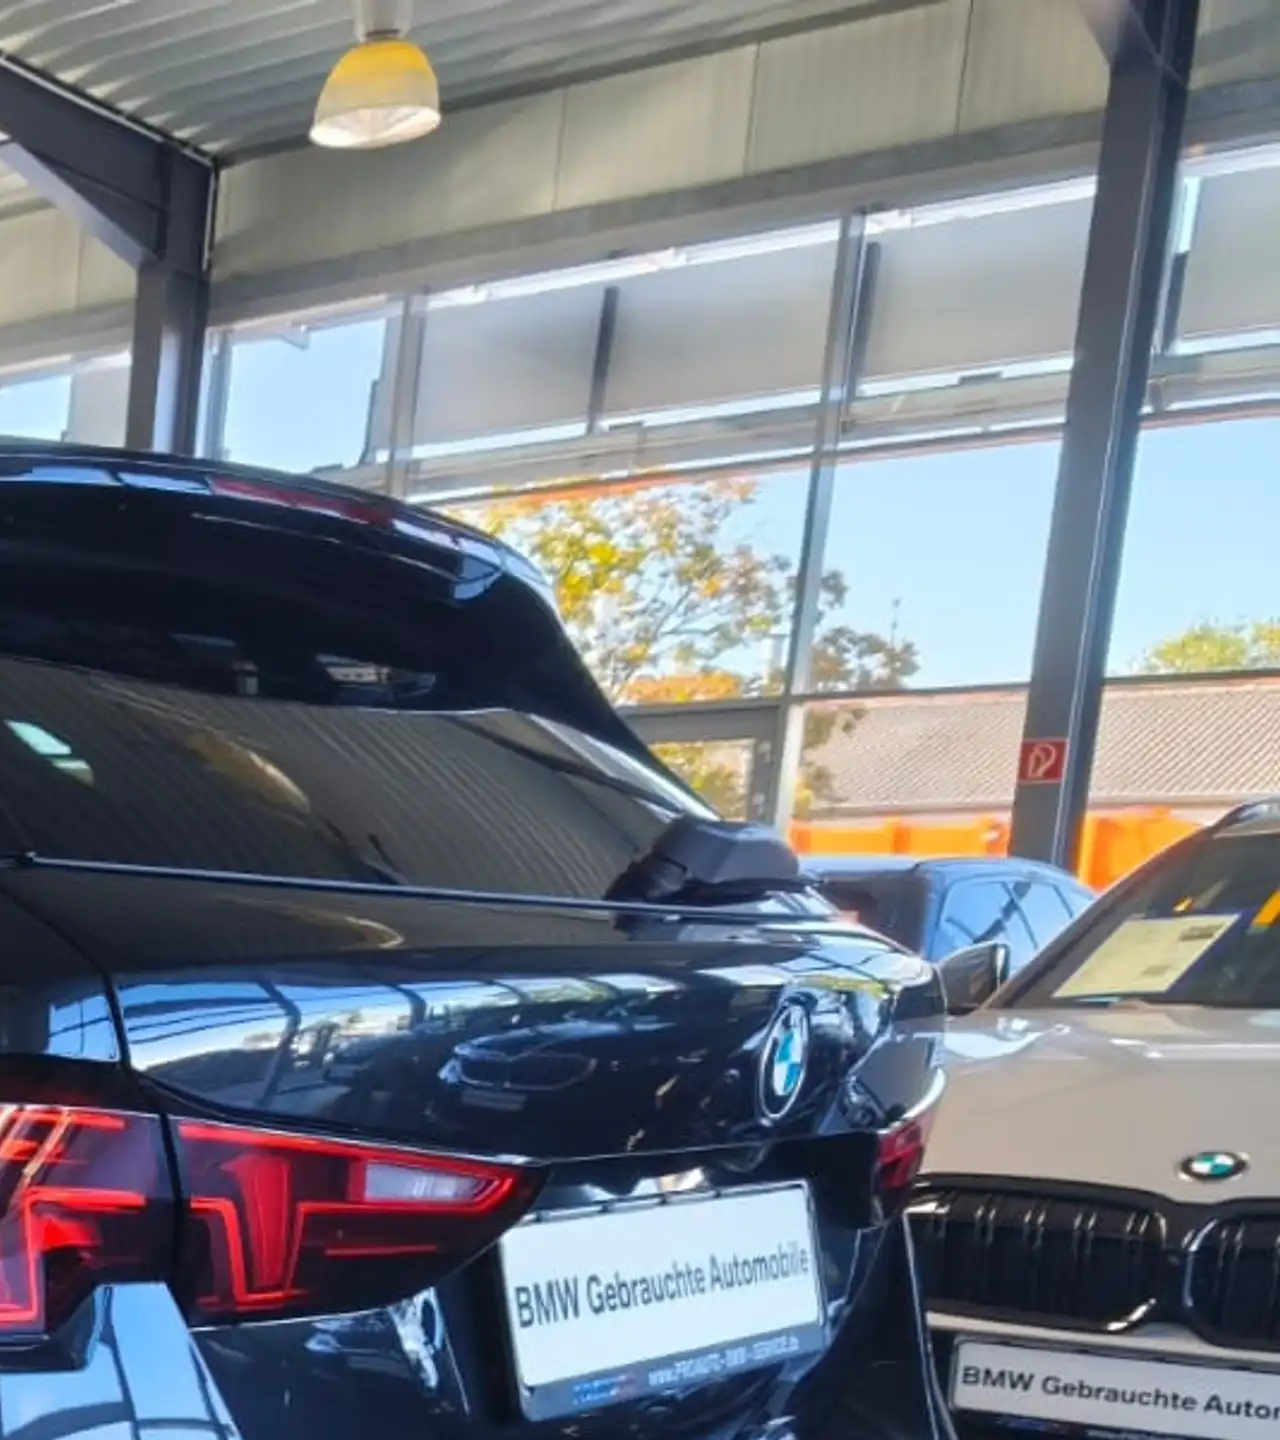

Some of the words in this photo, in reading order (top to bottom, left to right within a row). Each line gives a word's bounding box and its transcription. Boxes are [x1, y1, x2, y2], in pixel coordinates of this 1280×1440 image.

[514, 1275, 580, 1329] BMW
[586, 1258, 706, 1315] Gebrauchte
[709, 1241, 809, 1289] Automobile
[961, 1365, 1034, 1393] BMW
[1041, 1375, 1198, 1411] Gebrauchte
[1202, 1394, 1280, 1420] Auto
